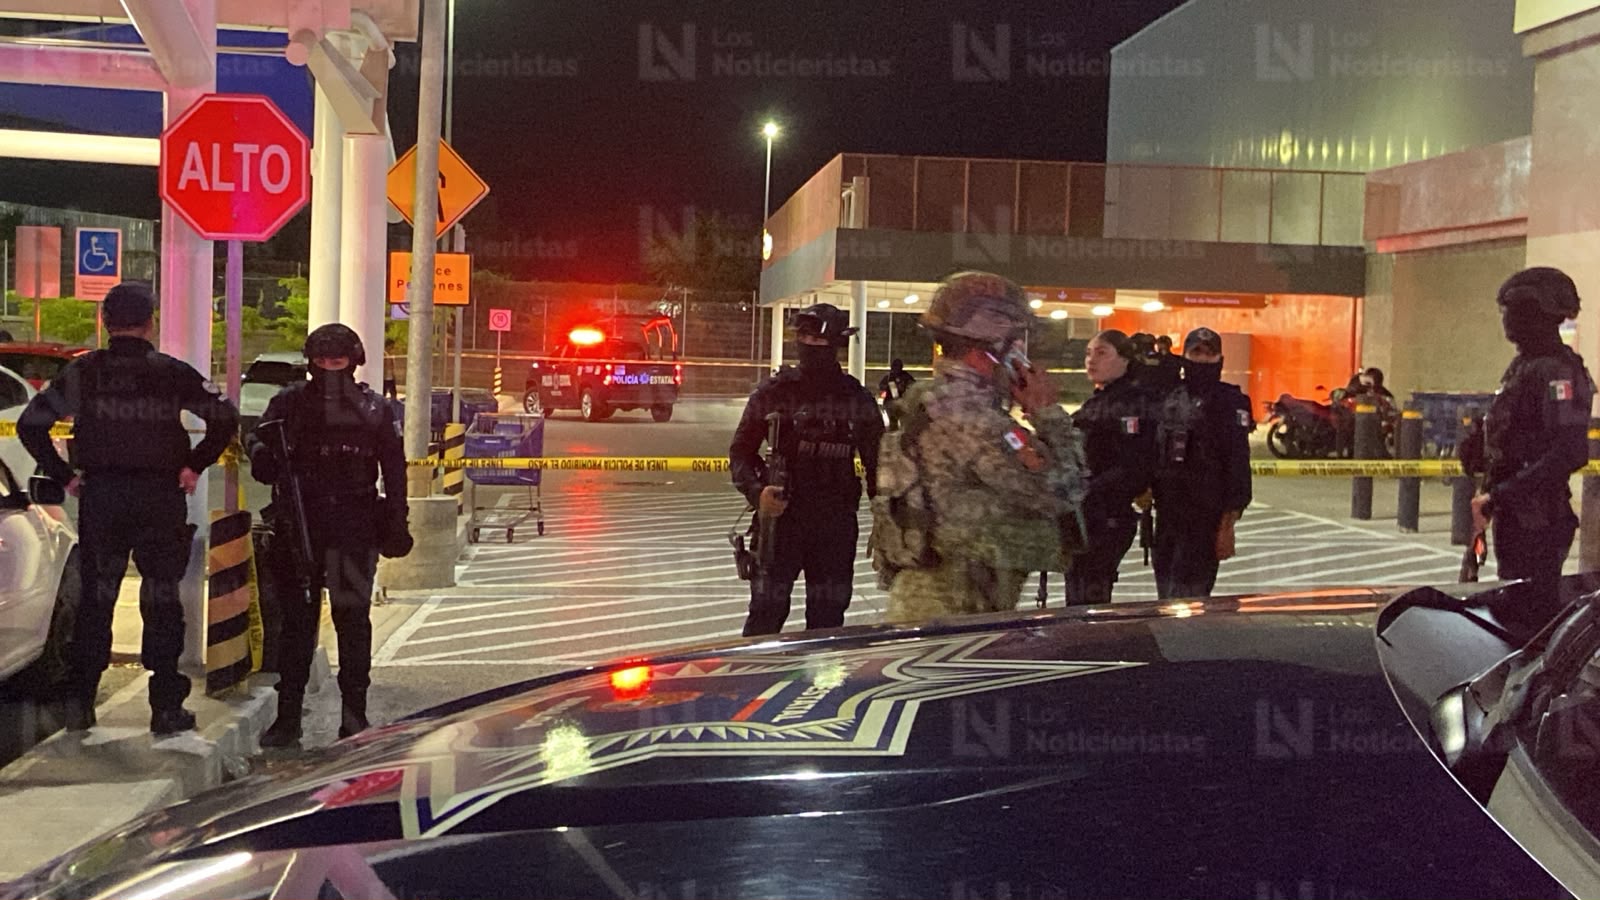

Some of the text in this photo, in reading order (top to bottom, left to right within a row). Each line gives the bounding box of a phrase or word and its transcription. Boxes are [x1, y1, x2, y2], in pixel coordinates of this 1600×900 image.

[177, 141, 292, 194] ALTO
[649, 375, 674, 385] ESTATAL
[528, 459, 668, 471] LINEA DE POLICIA PROHIBIDO EL PASO
[692, 460, 711, 471] PASO
[713, 460, 721, 471] EL
